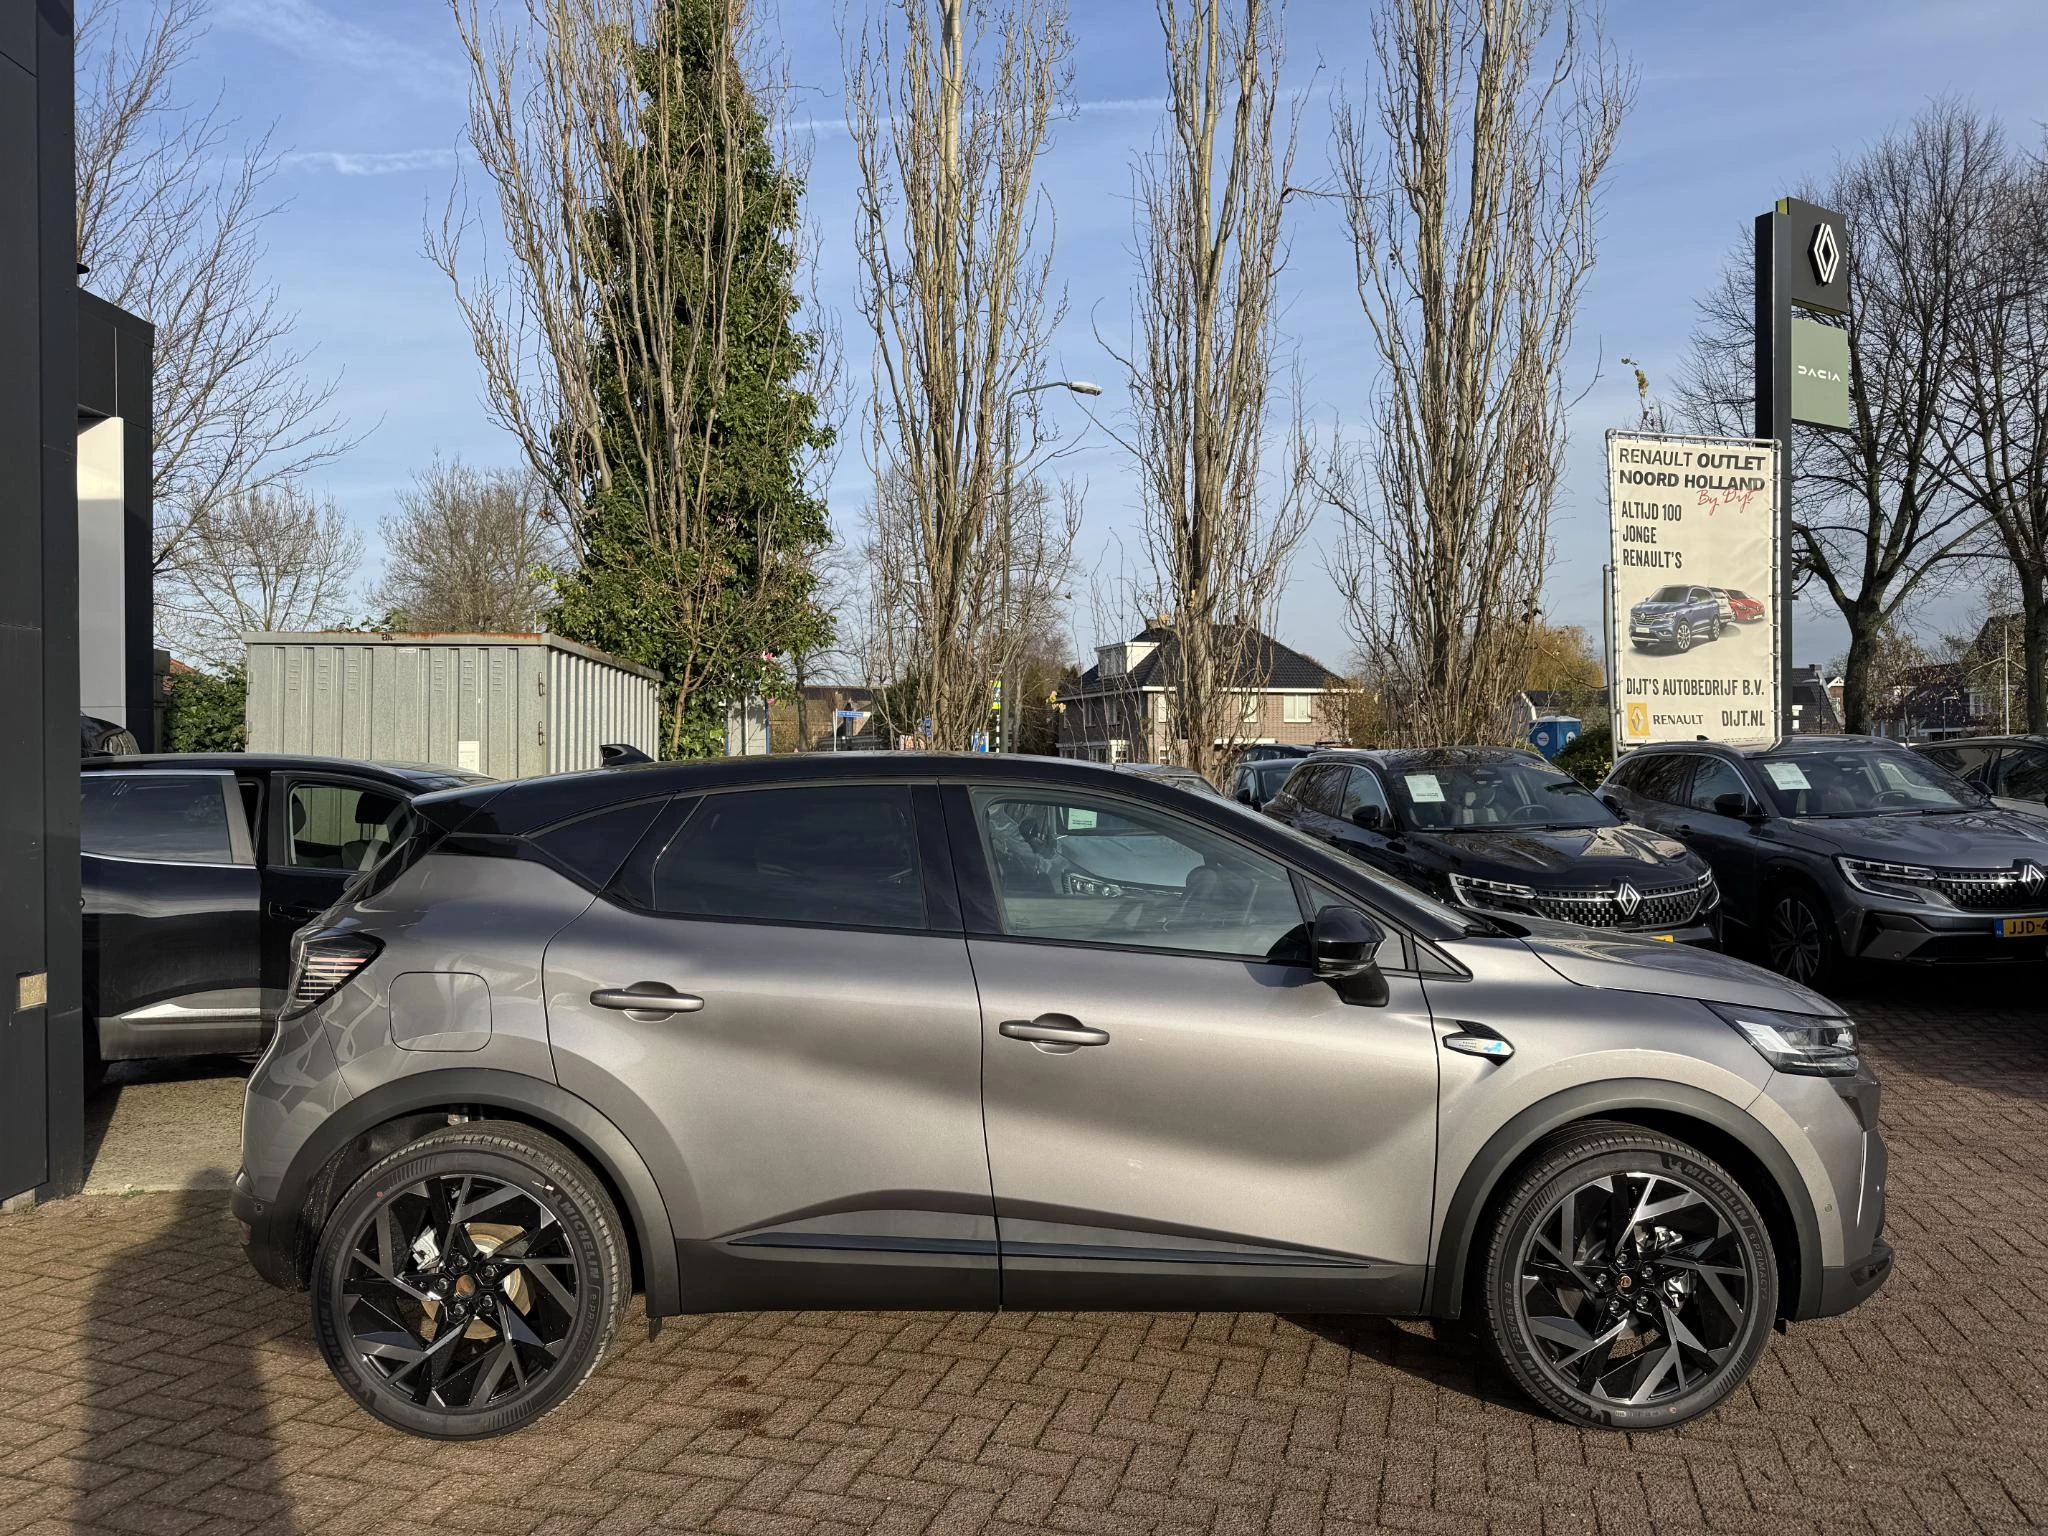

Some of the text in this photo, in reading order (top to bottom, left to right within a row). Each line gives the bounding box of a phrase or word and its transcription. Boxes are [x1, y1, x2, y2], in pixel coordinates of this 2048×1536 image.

[1798, 365, 1840, 382] DACIA
[1619, 448, 1766, 471] RENAULT OUTLET
[1619, 470, 1766, 491] NOORD HOLLAND
[1621, 501, 1682, 522] ALTIJD 100
[1696, 489, 1720, 516] By
[1622, 525, 1657, 544] JONGE
[1623, 549, 1682, 569] RENAULT'S
[1626, 678, 1765, 696] DIJT'S AUTOBEDRIJF B.V.
[1652, 710, 1766, 727] RENAULT DIJT.NL
[1685, 1164, 1749, 1221] MICHELIN
[560, 1202, 600, 1279] MICHELIN
[1520, 1358, 1590, 1417] MICHELIN
